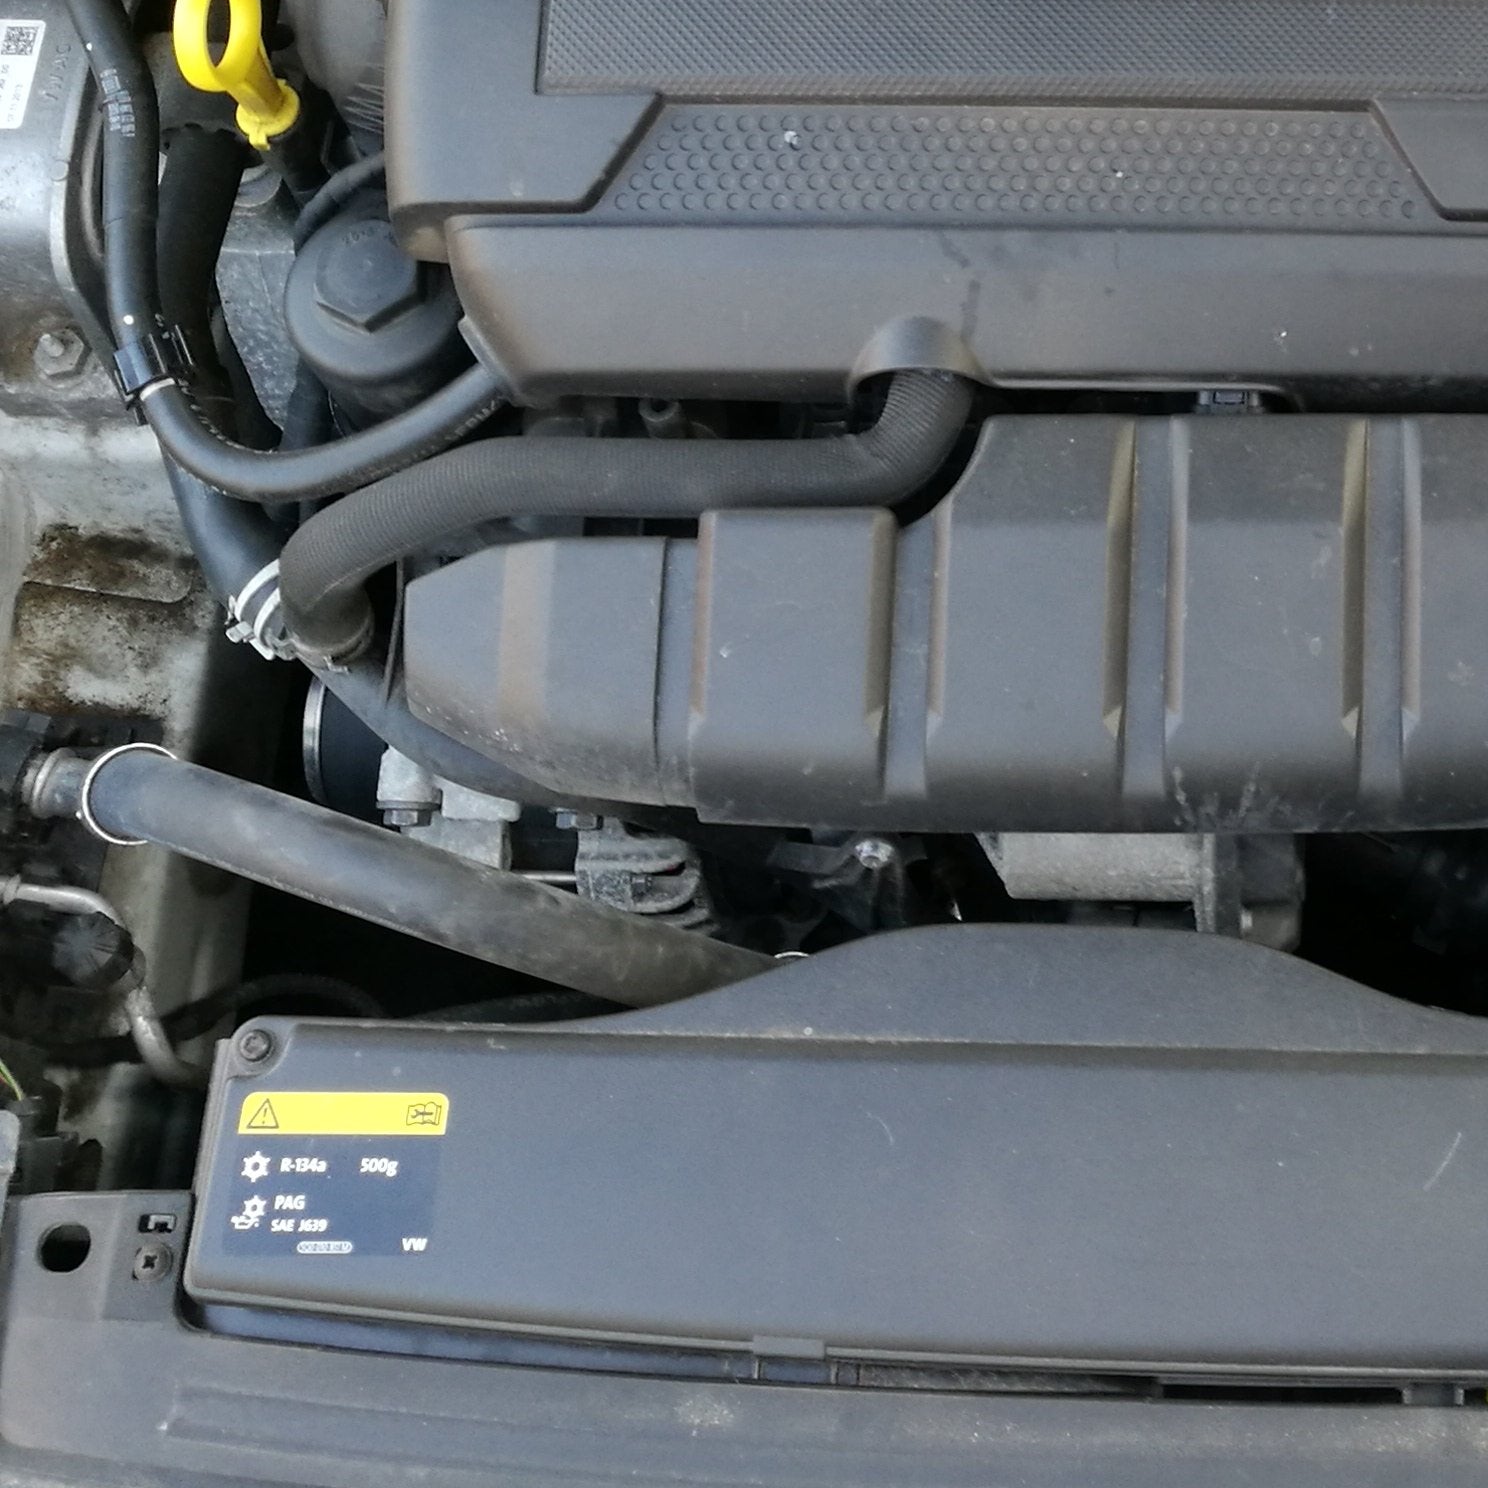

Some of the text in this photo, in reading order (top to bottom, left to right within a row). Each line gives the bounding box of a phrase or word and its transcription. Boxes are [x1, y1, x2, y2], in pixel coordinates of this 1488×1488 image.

[280, 1157, 399, 1177] R-134a 500g
[273, 1194, 306, 1211] PAG
[270, 1219, 328, 1233] SAE J639
[402, 1238, 427, 1251] VW
